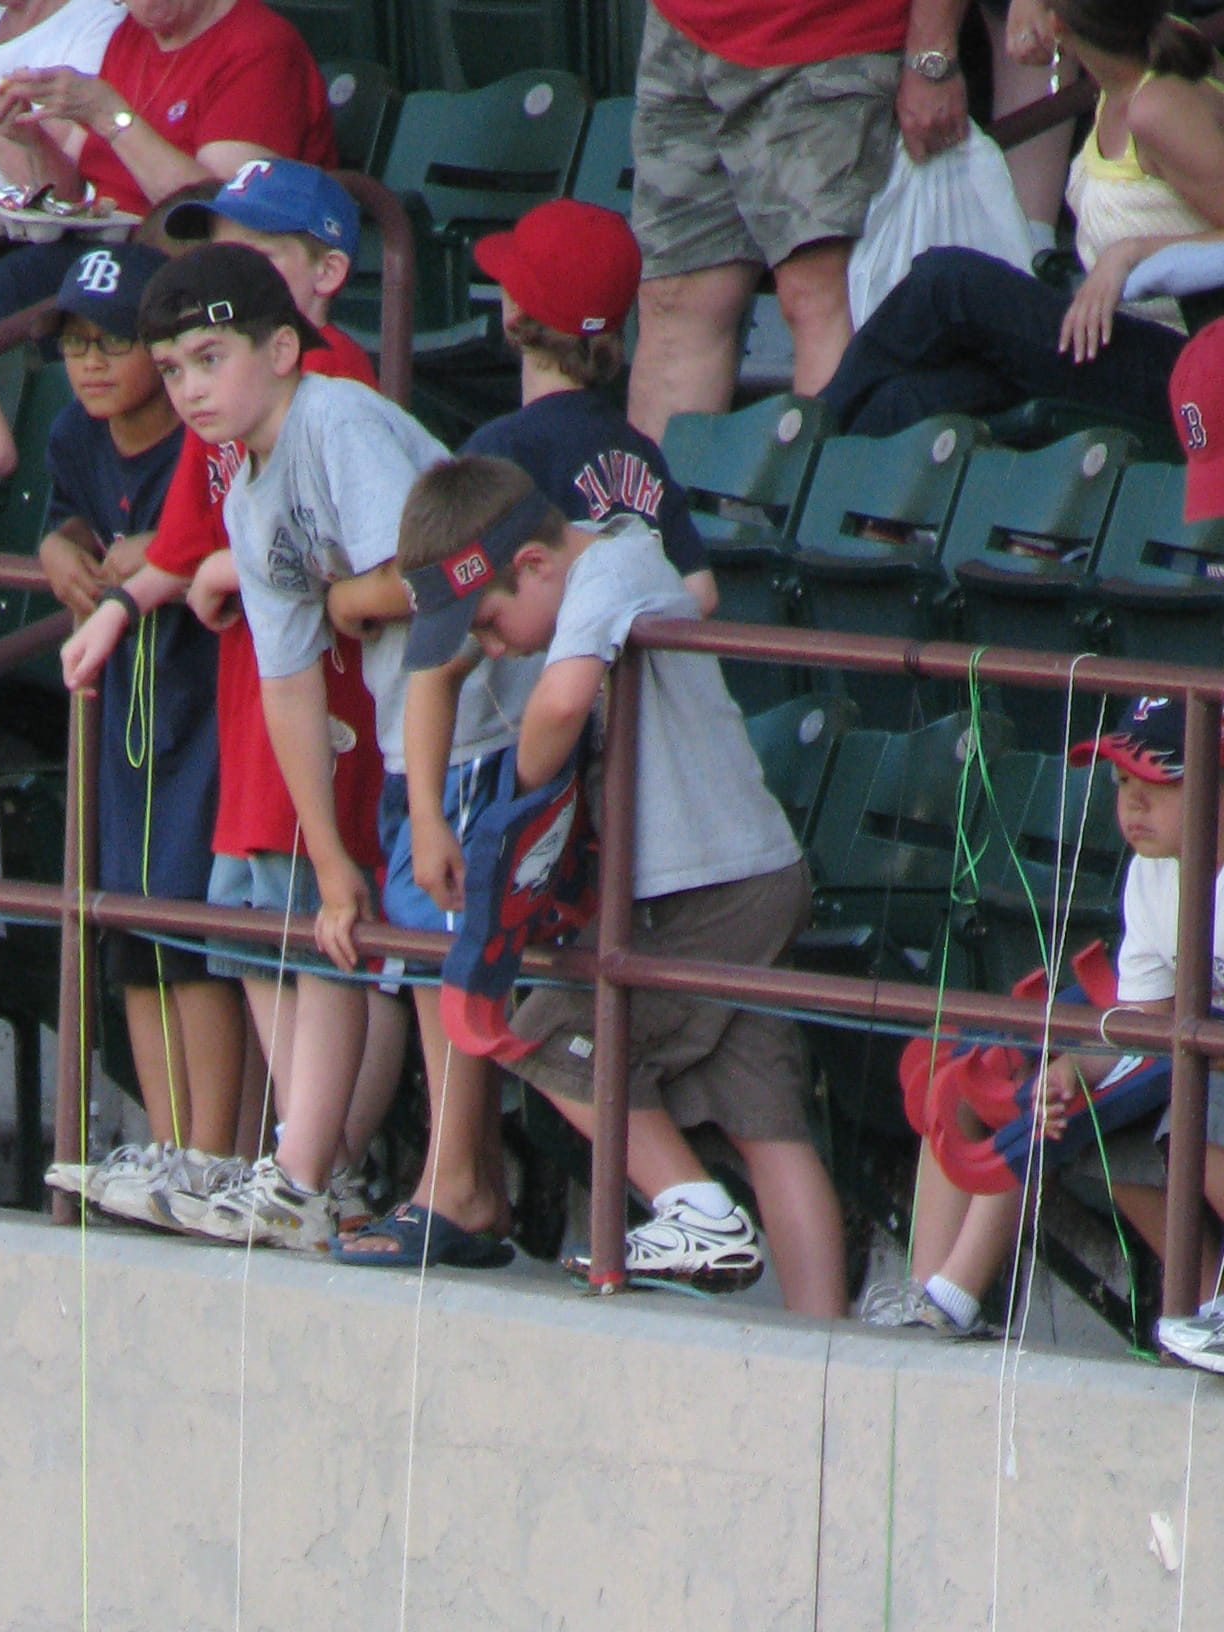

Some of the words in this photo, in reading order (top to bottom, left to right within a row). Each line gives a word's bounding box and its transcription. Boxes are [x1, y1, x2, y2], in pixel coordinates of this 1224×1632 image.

[227, 159, 272, 192] T
[77, 250, 122, 294] TB
[1181, 402, 1207, 449] B
